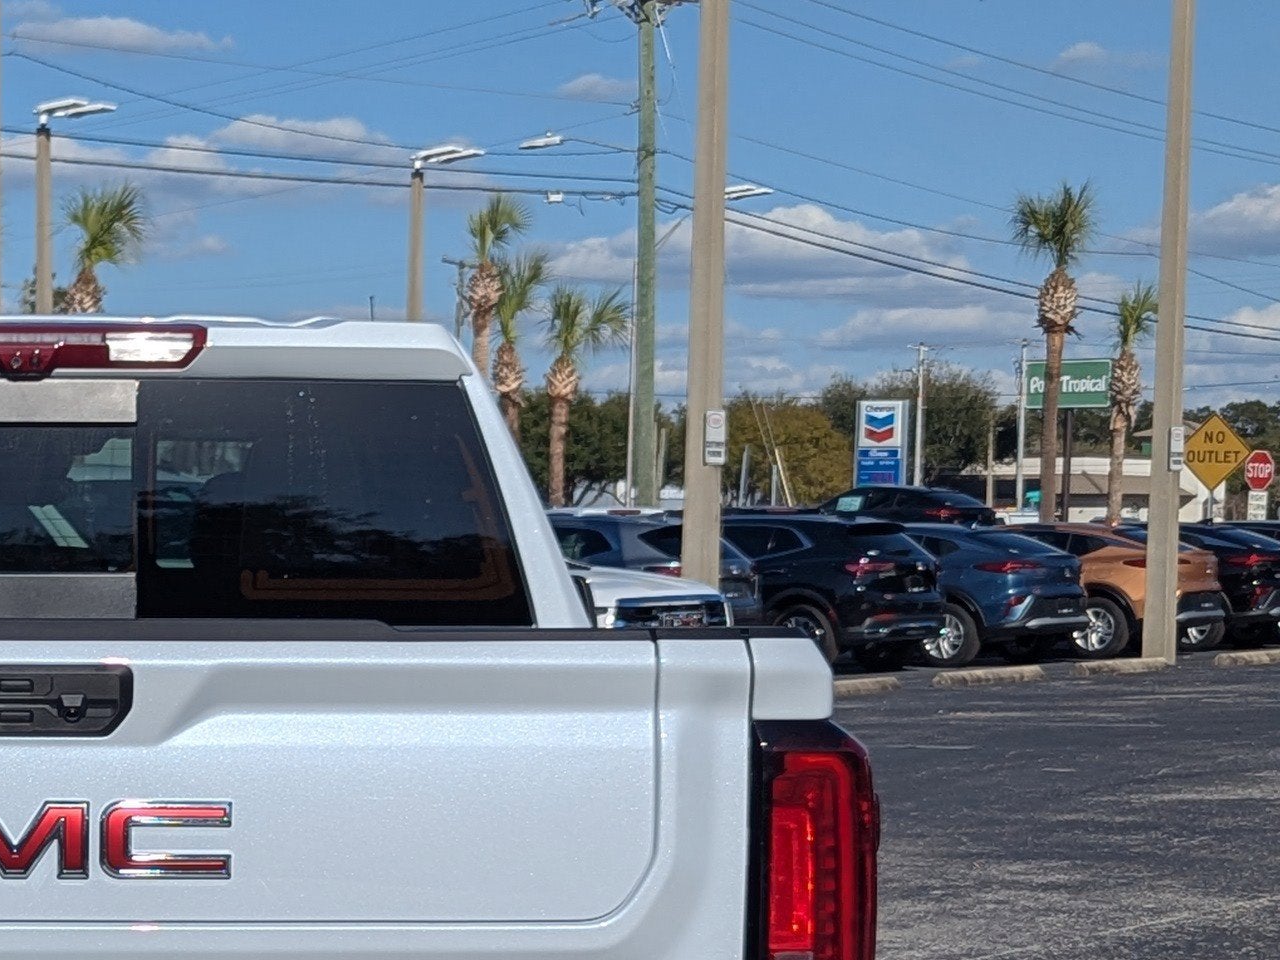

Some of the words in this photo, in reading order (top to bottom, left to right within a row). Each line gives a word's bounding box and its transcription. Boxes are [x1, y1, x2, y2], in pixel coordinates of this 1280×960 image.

[1060, 375, 1107, 393] Tropical
[1204, 431, 1225, 444] NO
[1186, 450, 1241, 463] OUTLET
[1247, 463, 1271, 478] STOP
